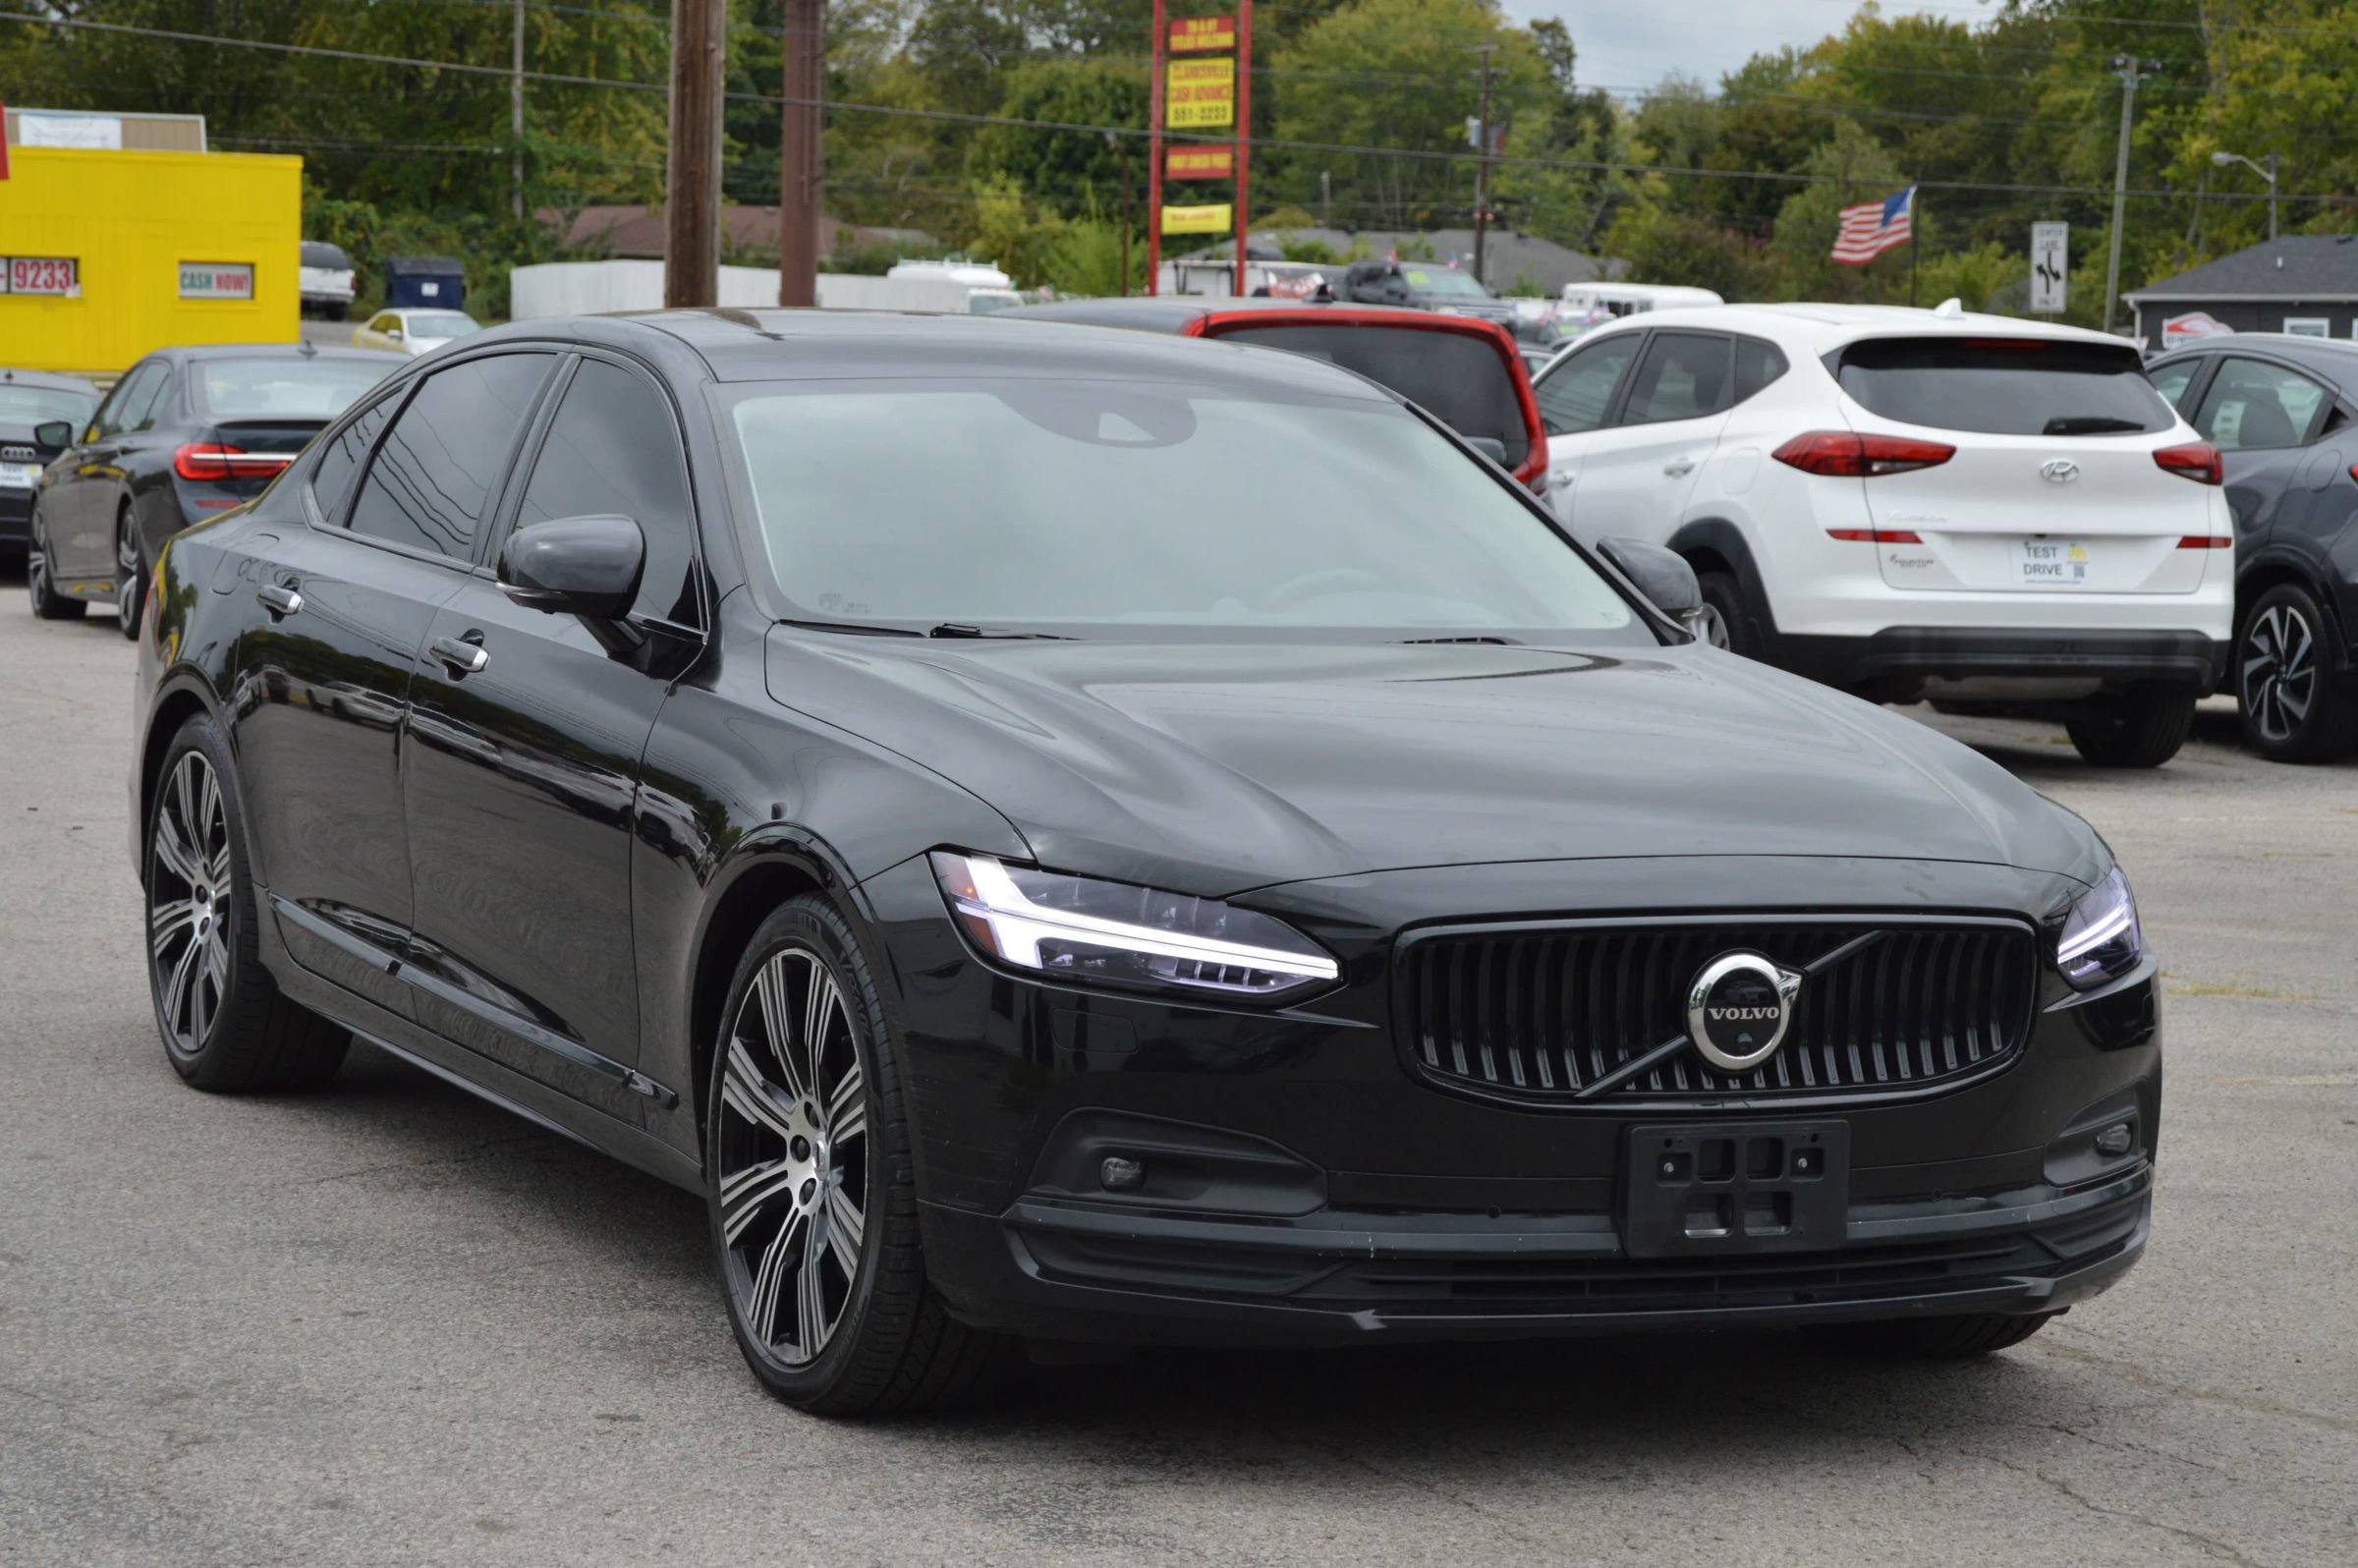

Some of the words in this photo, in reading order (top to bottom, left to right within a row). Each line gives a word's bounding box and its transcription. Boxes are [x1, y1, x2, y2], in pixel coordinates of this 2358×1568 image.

[180, 272, 213, 291] CASH
[215, 273, 250, 291] NOW!
[2026, 546, 2058, 559] TEST
[2023, 563, 2063, 576] DRIVE
[1708, 1006, 1779, 1020] VOLVO
